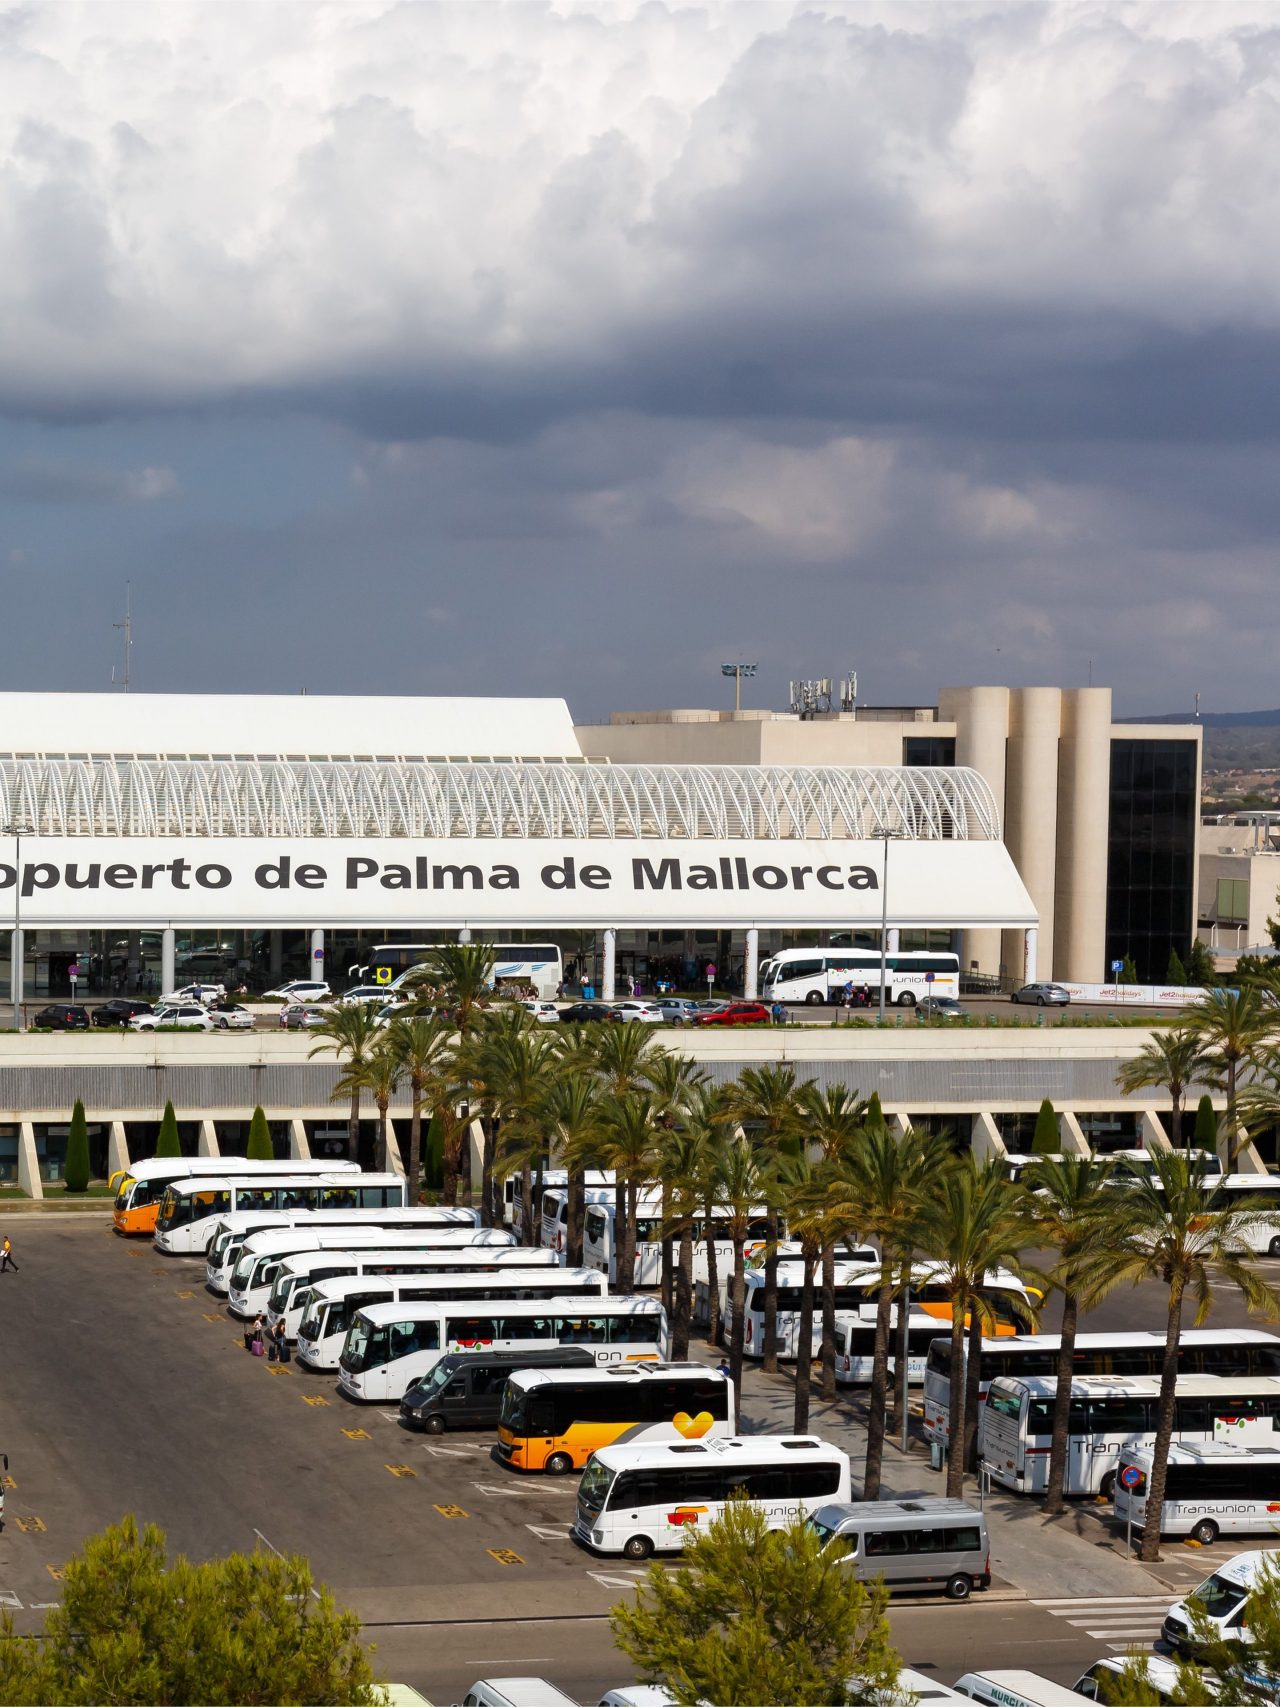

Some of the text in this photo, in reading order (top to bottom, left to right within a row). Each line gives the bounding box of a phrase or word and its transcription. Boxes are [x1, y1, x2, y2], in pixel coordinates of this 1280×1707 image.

[254, 856, 328, 889] de
[346, 856, 520, 889] Palma
[540, 856, 612, 889] de
[631, 857, 879, 890] Mallorca
[1175, 1503, 1256, 1514] Transunion
